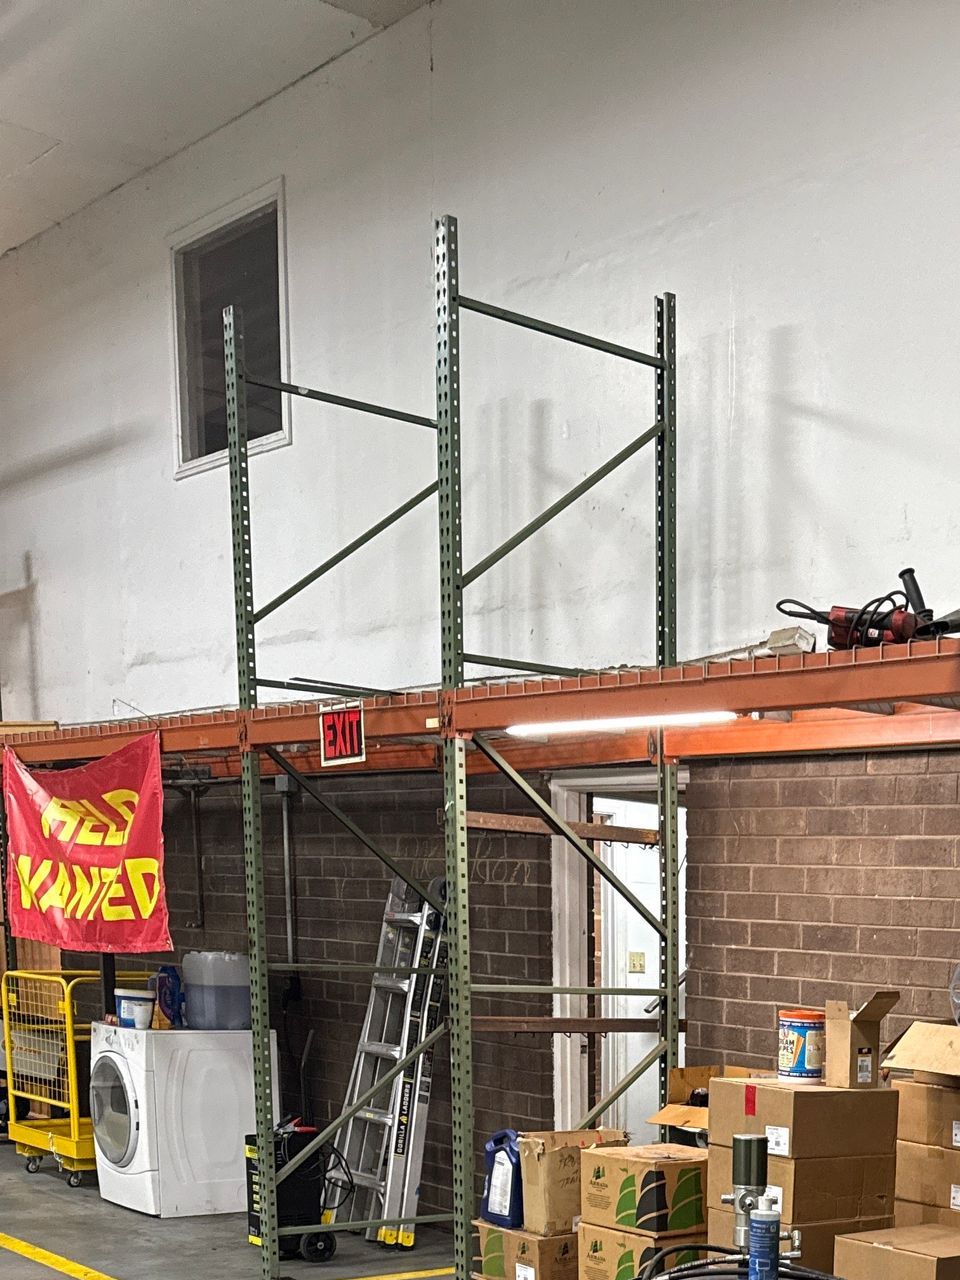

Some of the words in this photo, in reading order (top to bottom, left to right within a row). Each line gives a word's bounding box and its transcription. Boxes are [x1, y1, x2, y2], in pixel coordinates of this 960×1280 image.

[323, 709, 360, 758] EXIT
[397, 1126, 405, 1153] GORILLA
[402, 1084, 411, 1114] LADDERS
